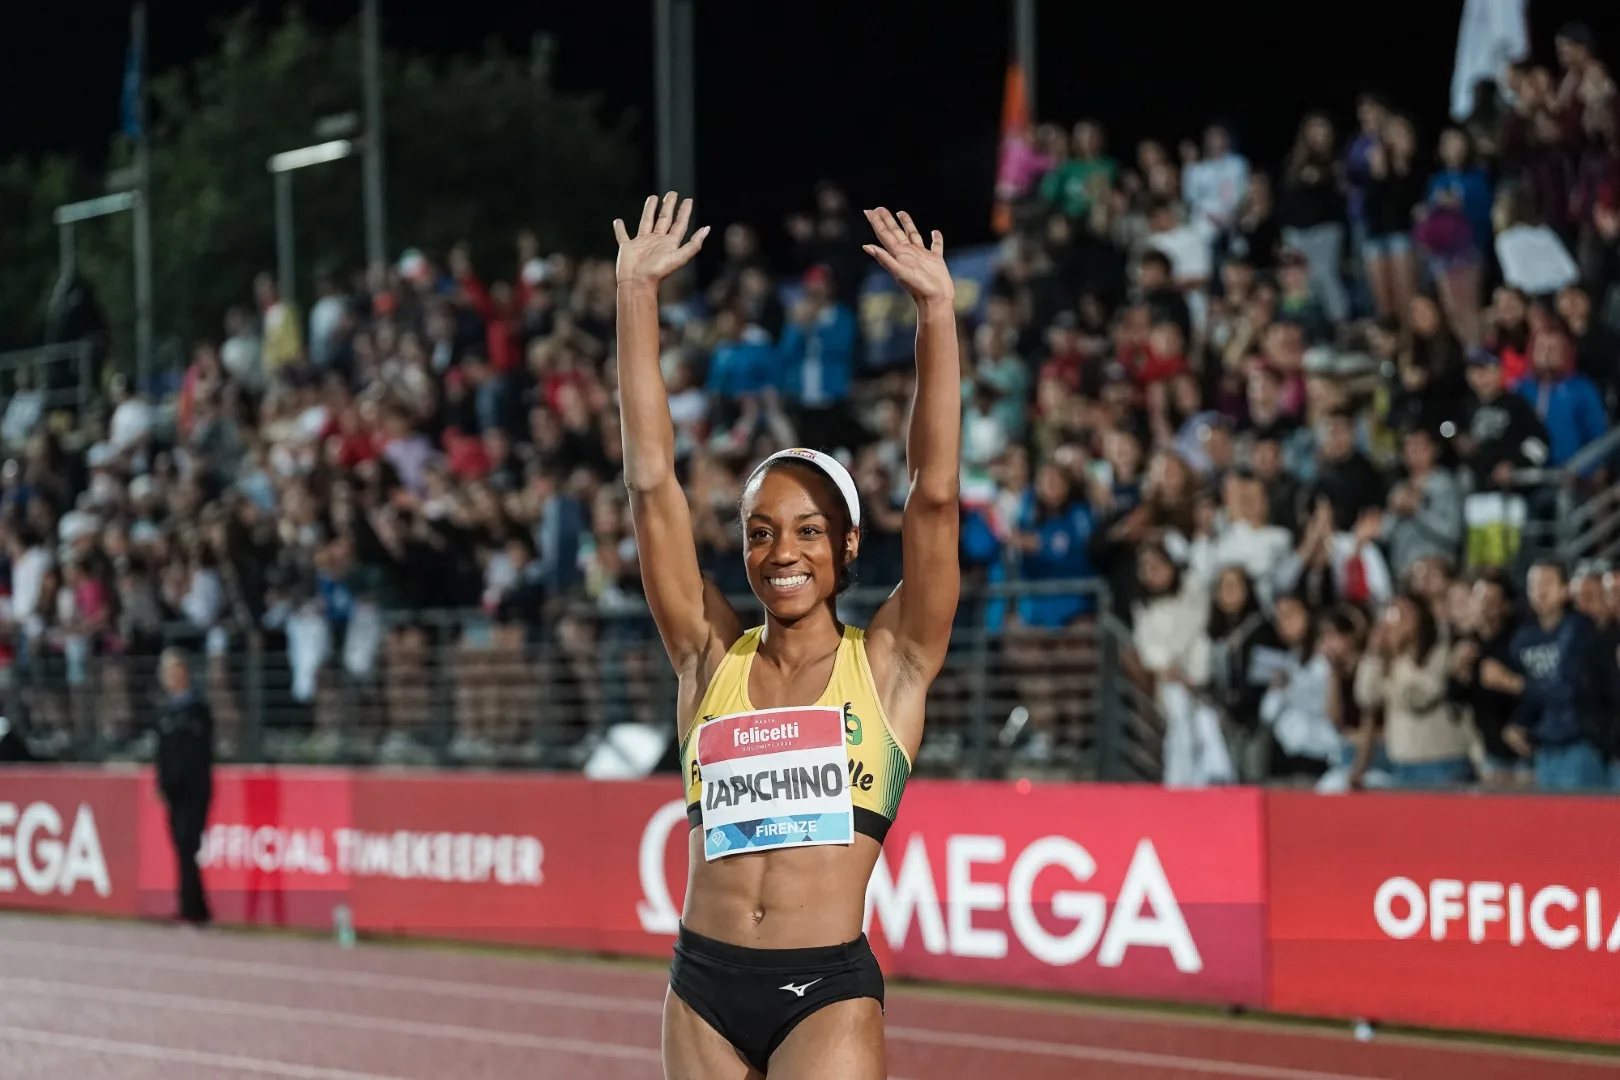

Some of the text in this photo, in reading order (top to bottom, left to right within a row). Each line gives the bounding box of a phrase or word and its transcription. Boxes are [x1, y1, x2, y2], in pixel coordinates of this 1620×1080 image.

[733, 721, 799, 748] felicetti
[705, 762, 843, 811] IAPICHINO
[755, 819, 818, 838] FIRENZE
[333, 828, 544, 886] TIMEKEEPER
[862, 831, 1203, 973] MEGA
[1373, 875, 1620, 953] OFFICI
